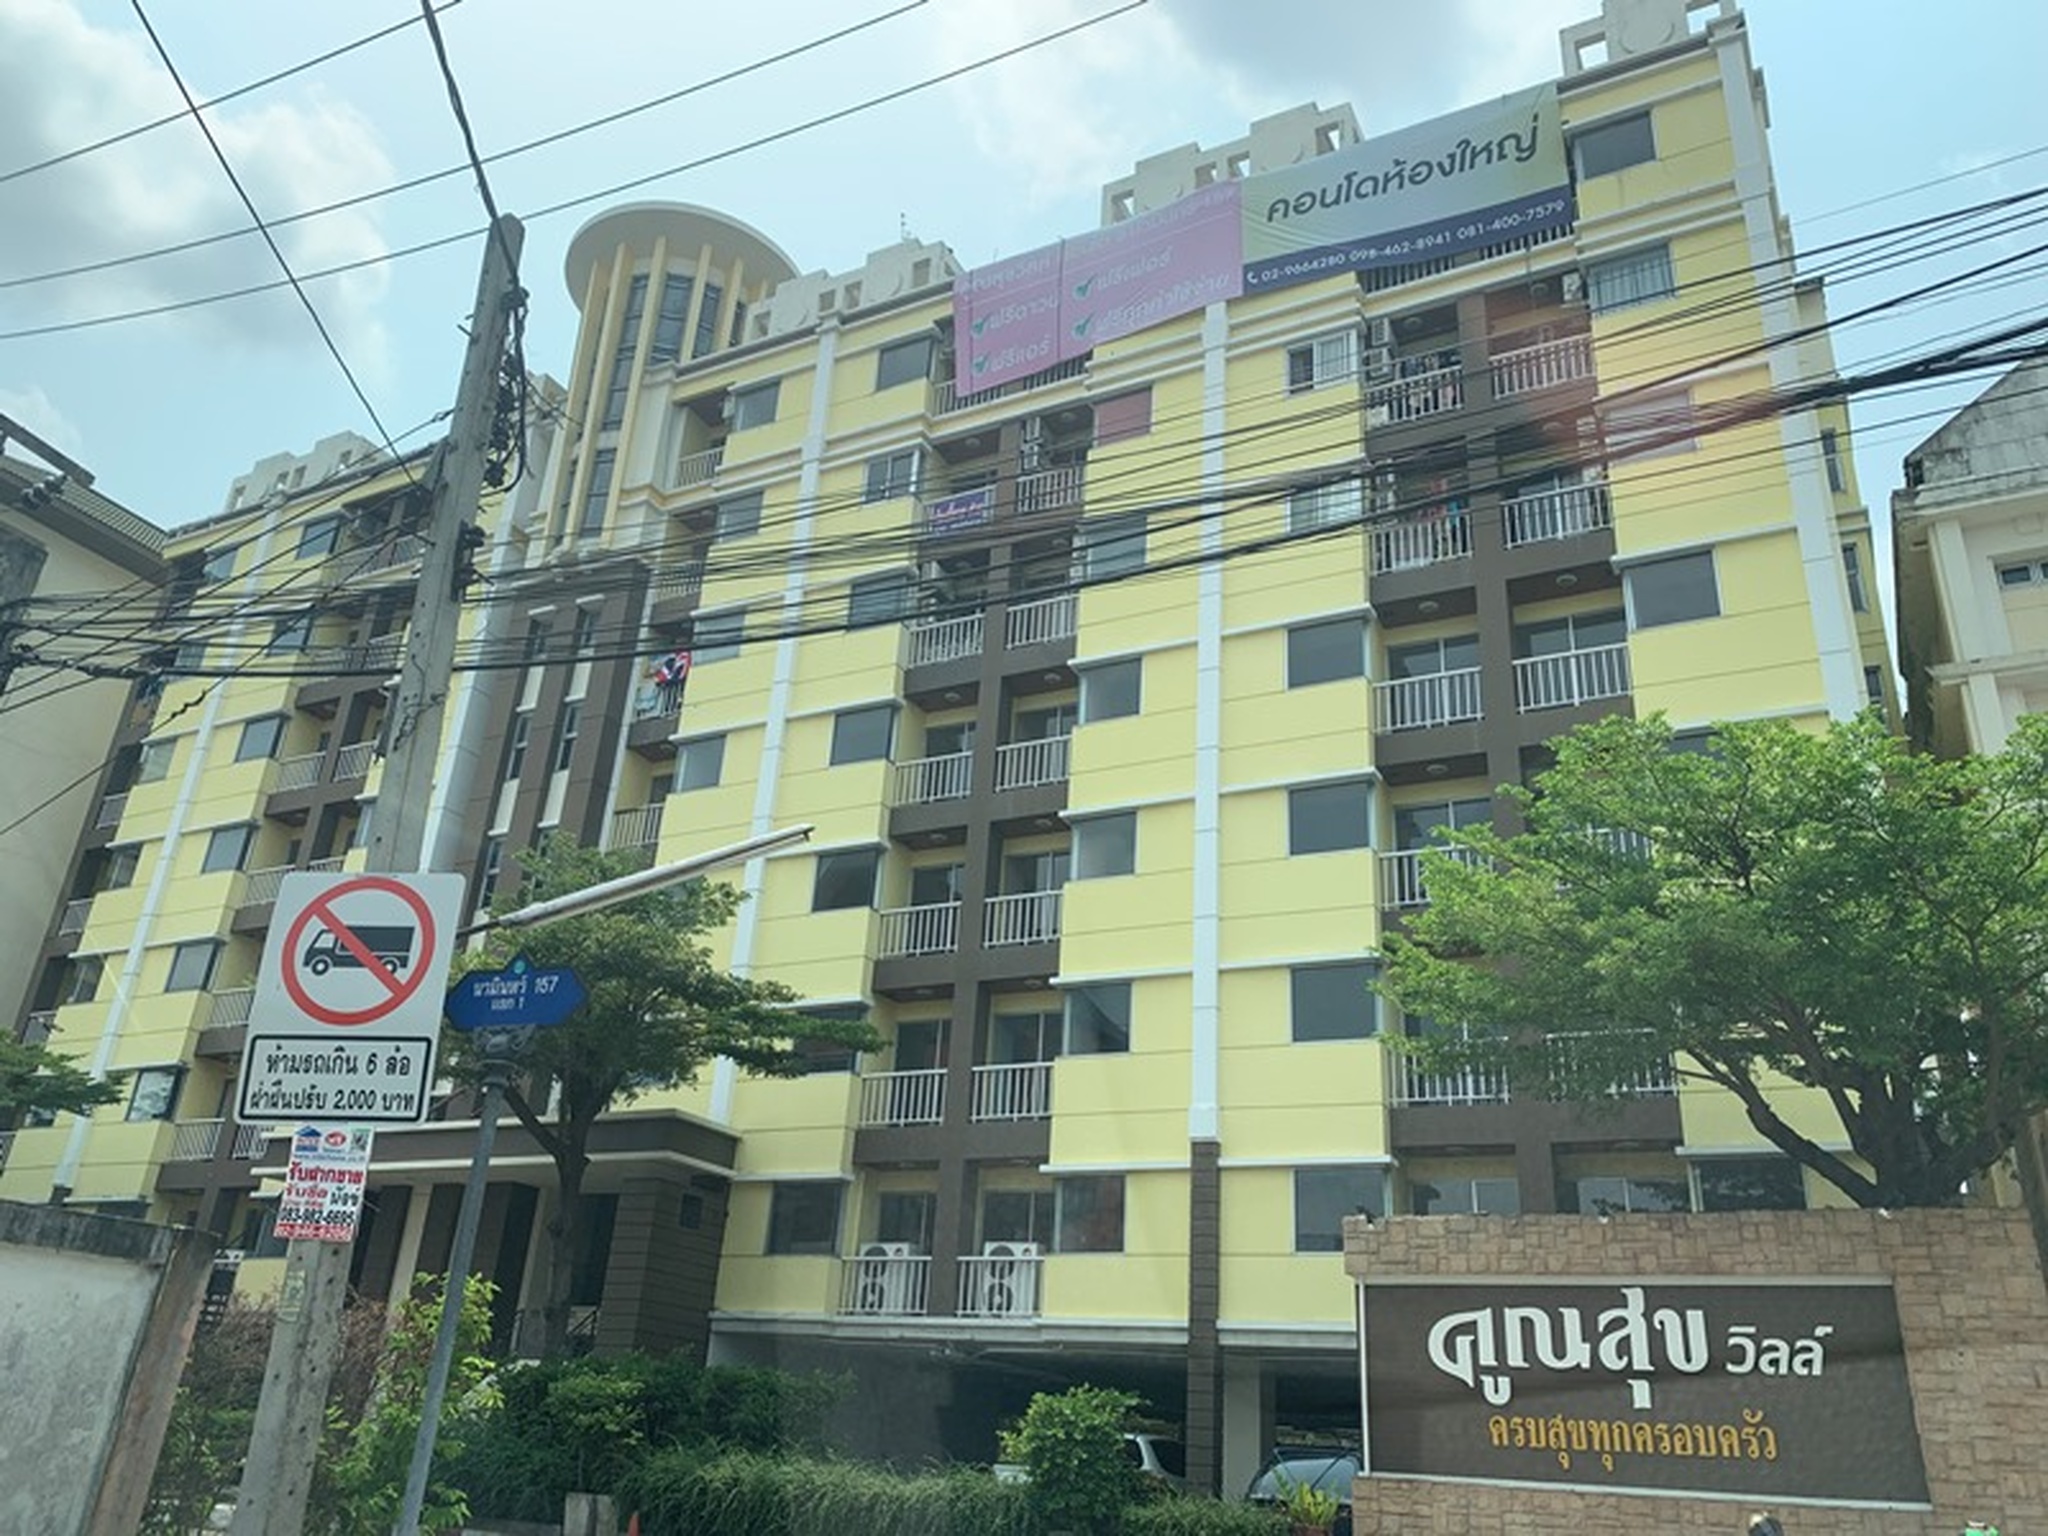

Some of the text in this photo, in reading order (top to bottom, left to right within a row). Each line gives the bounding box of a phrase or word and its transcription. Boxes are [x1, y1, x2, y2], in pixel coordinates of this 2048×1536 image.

[1266, 113, 1540, 222] คอนโดห้องใหญ่
[535, 975, 560, 994] 157
[266, 1043, 411, 1076] ห้ามรถเกิน 6 ล้อ
[250, 1078, 328, 1110] ฝ่าฝืนปรับ
[382, 1092, 415, 1112] บาท
[1427, 1286, 1834, 1409] คูณสุข วิลล์
[1488, 1408, 1779, 1472] ครบสุขทุกครอบครัว
